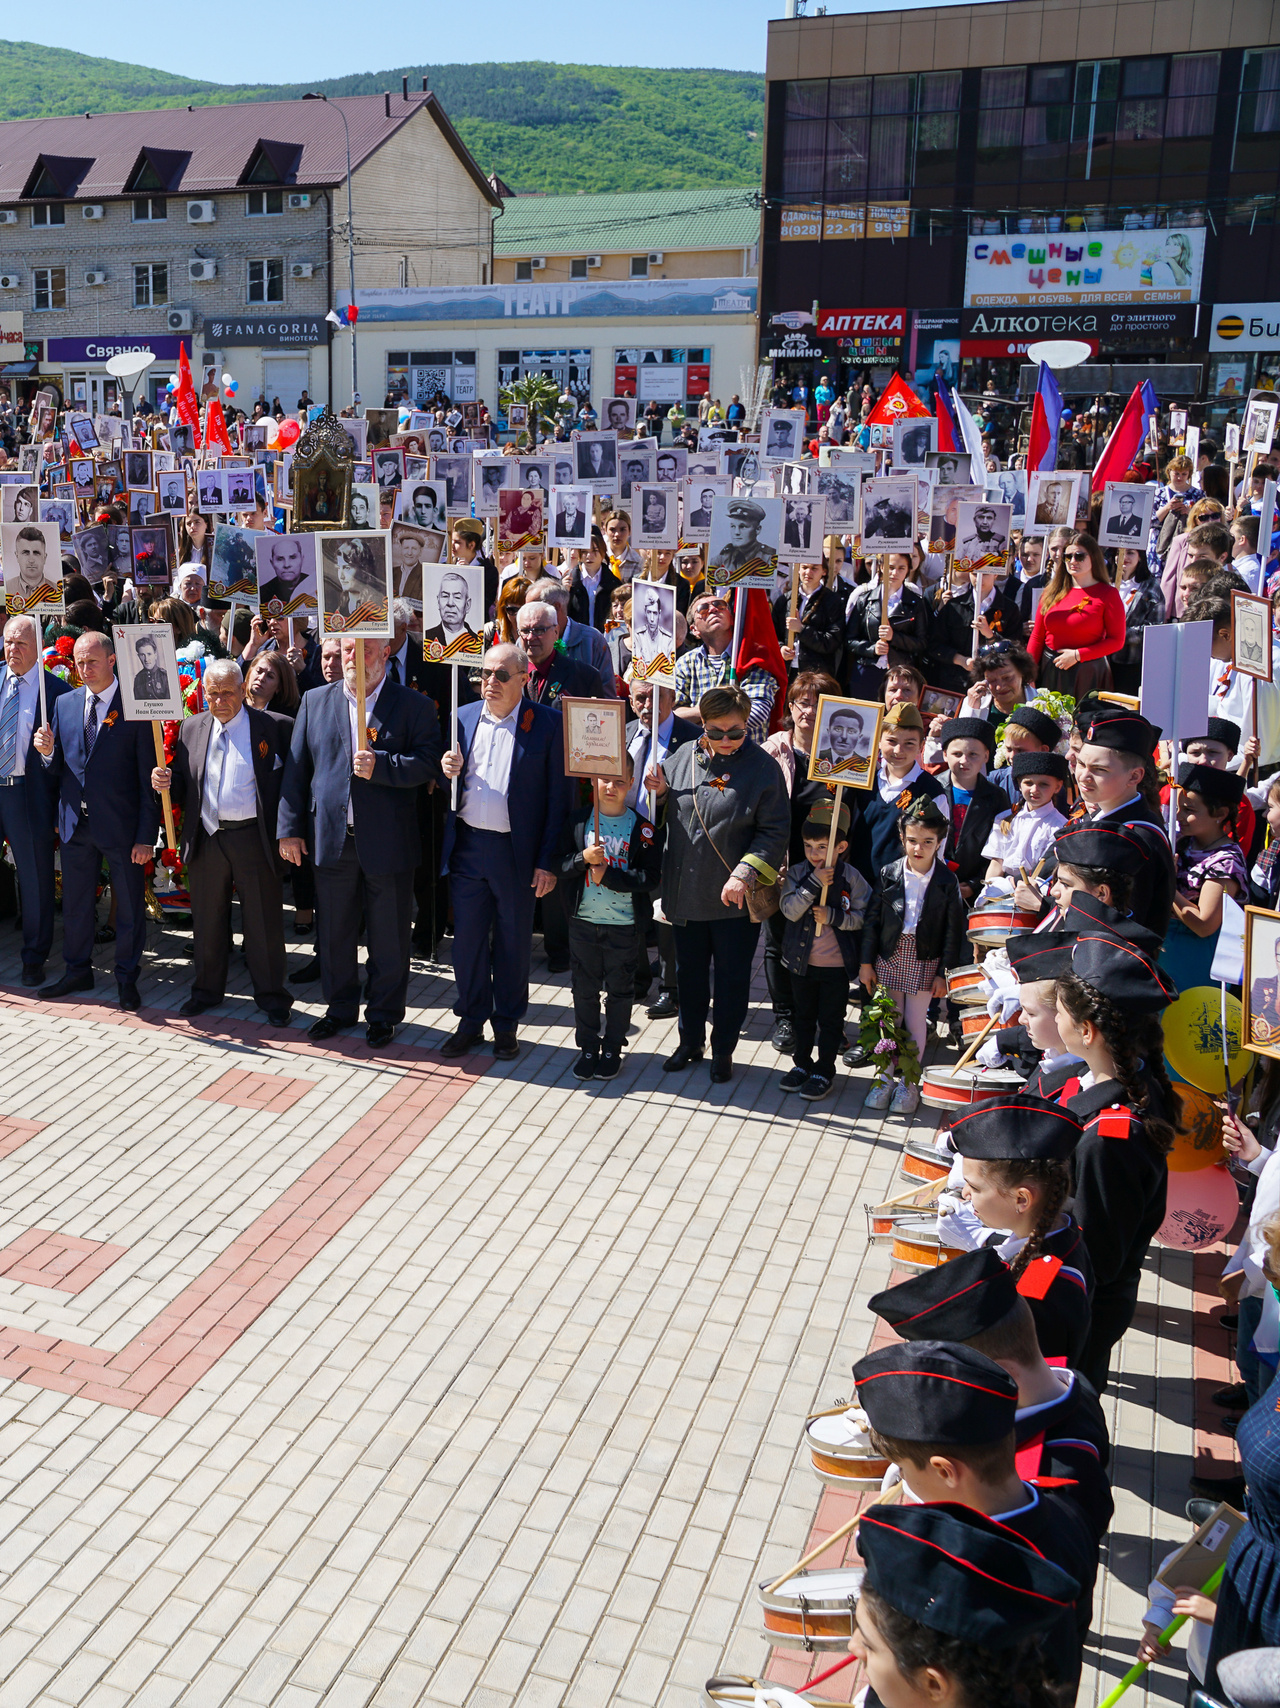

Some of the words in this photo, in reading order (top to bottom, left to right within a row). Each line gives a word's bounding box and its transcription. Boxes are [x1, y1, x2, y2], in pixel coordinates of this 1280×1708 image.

[825, 208, 865, 220] УЮТНЫЕ
[825, 222, 864, 235] 22-11
[874, 222, 902, 233] 999
[502, 286, 577, 316] ТЕАТР
[718, 299, 747, 307] ТЕАТР
[975, 295, 1018, 305] ОДЕЖДА
[1028, 295, 1037, 304] И
[1038, 294, 1073, 304] ОБУВЬ
[1079, 293, 1102, 304] ДЛЯ
[1103, 291, 1133, 302] ВСЕЙ
[1143, 291, 1181, 301] СЕМЬИ
[821, 314, 903, 331] АПТЕКА
[1111, 313, 1124, 322] От
[1126, 313, 1176, 322] элитного
[225, 322, 319, 335] FANAGORIA
[1109, 323, 1123, 331] до
[1124, 322, 1170, 331] простого
[784, 333, 807, 341] КАФЕ
[837, 337, 901, 347] СМЕШНЫЕ
[769, 348, 822, 358] МИМИНО
[848, 346, 887, 356] ЦЕНЫ
[456, 386, 474, 394] ТЕАТР
